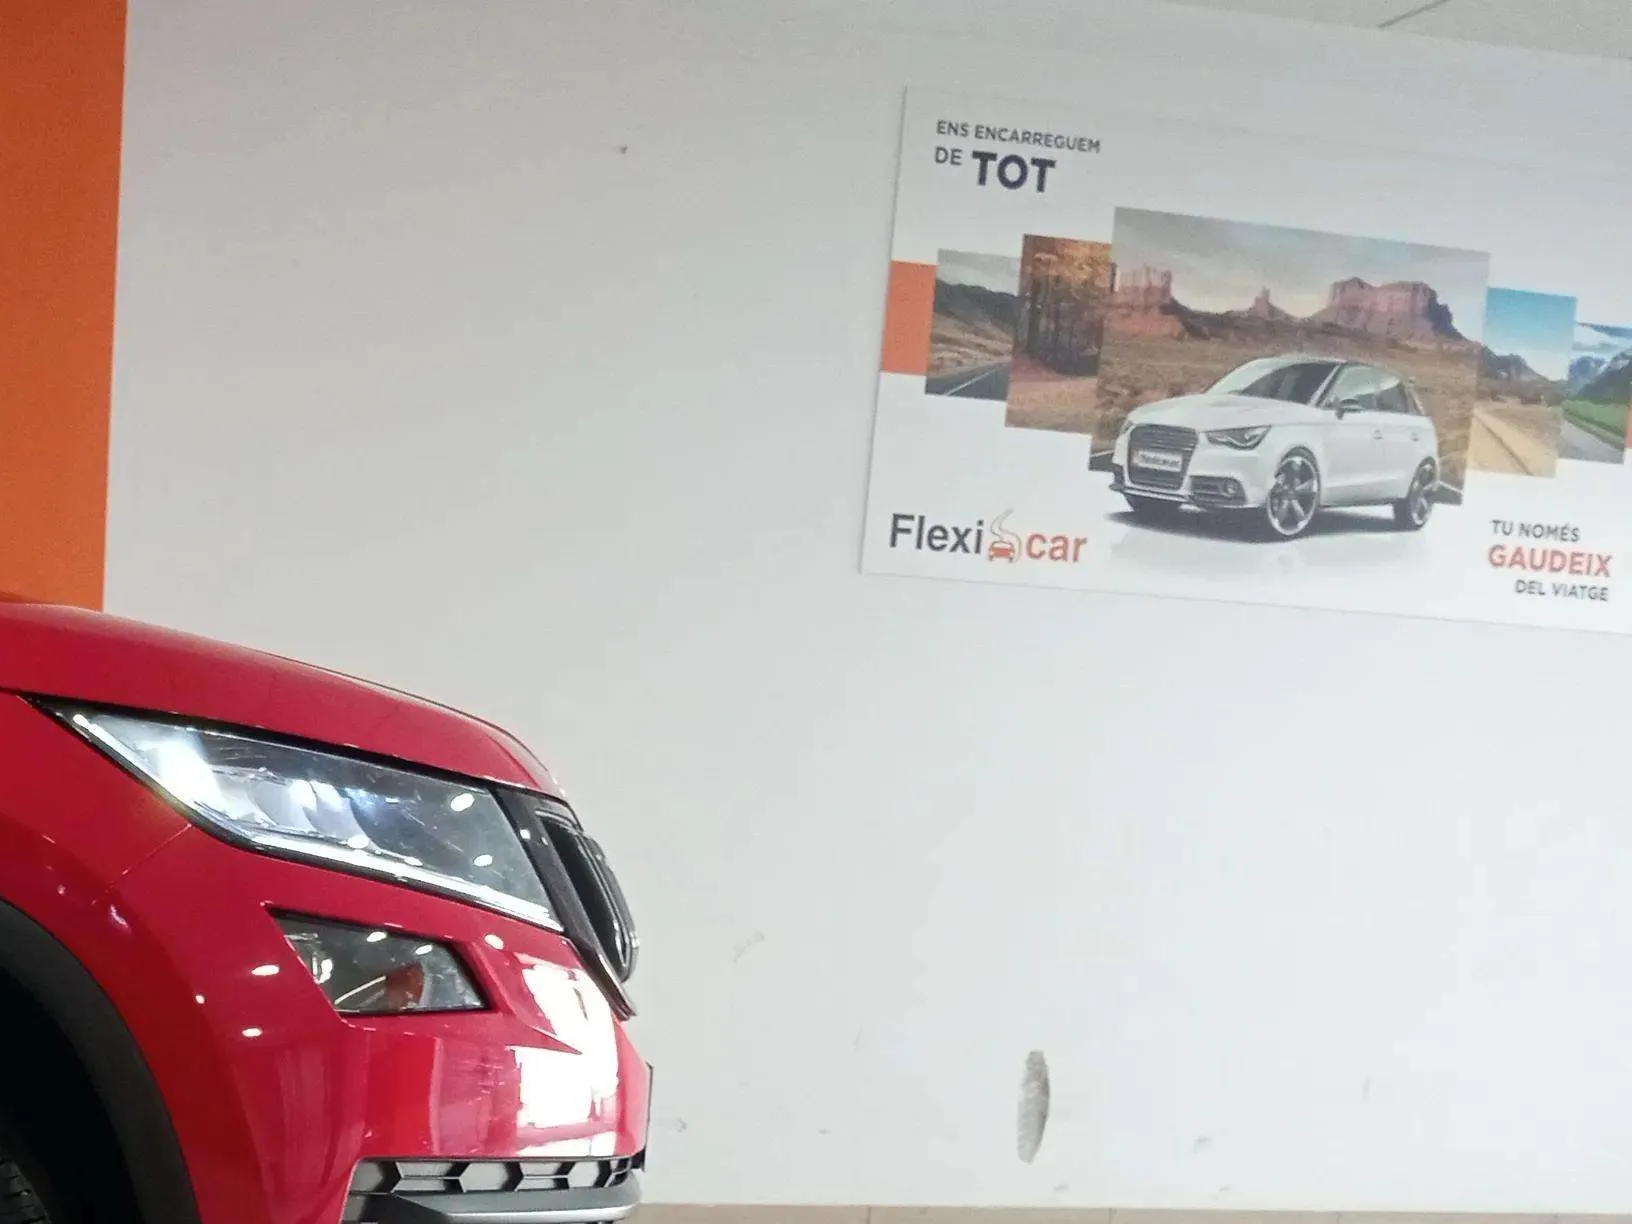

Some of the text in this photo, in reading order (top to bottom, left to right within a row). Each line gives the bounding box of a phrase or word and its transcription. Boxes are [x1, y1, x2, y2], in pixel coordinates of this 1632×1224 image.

[936, 119, 1102, 154] ENS ENCARREGUEM
[934, 146, 1058, 193] DE TOT
[1492, 519, 1580, 542] TU NOMÉS
[1487, 543, 1613, 578] GAUDEIX
[1515, 579, 1609, 602] DEL VIATGE
